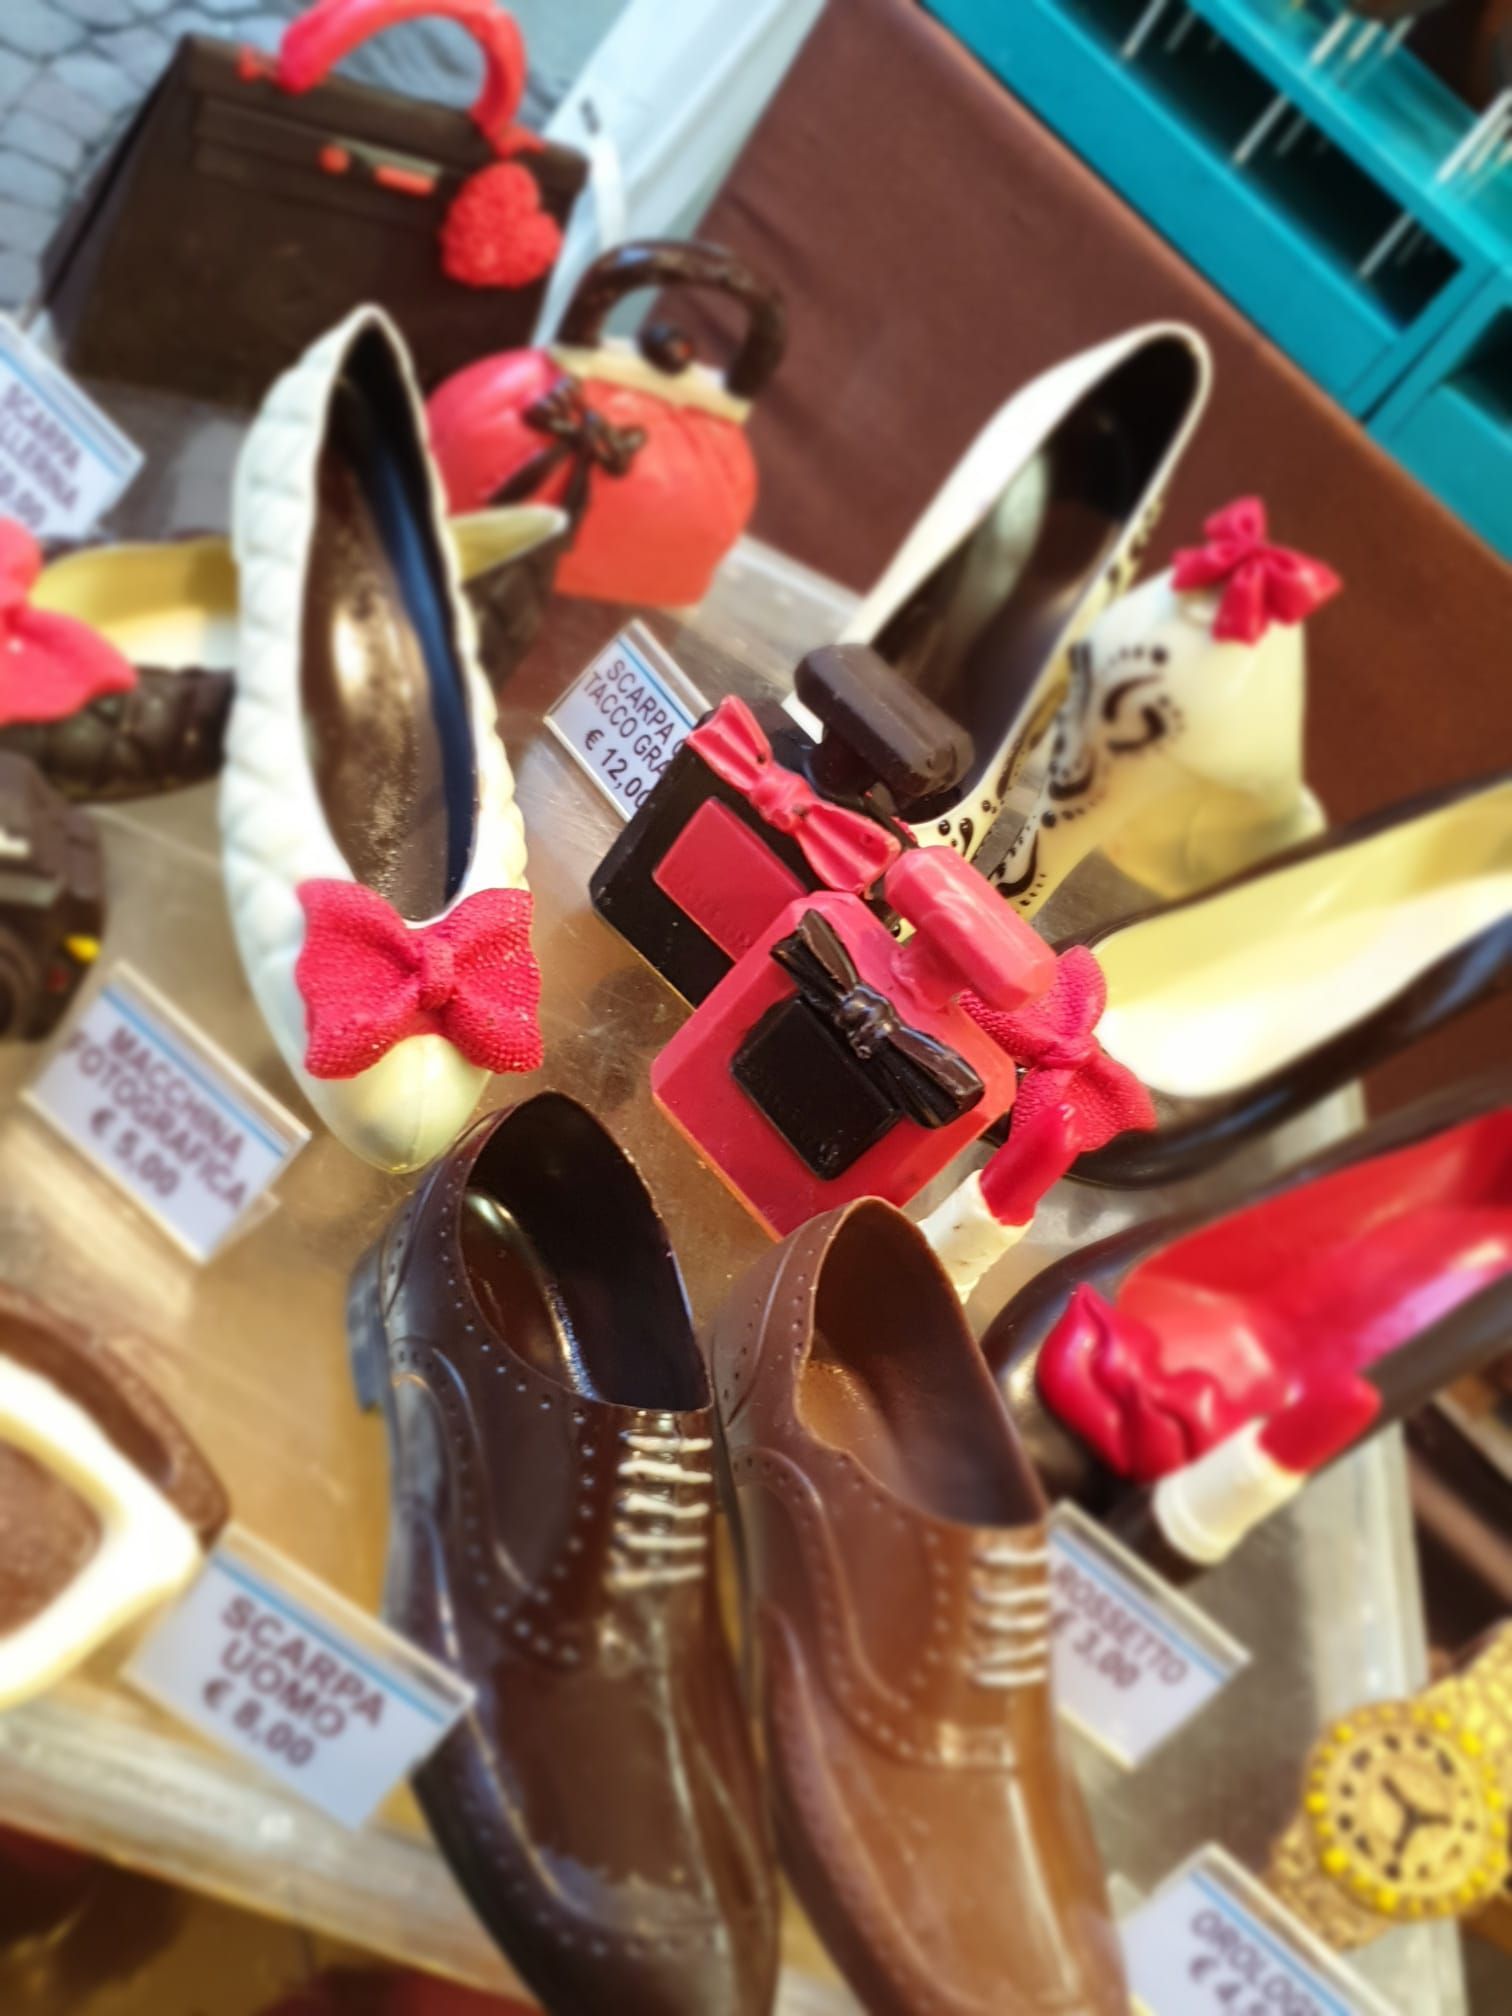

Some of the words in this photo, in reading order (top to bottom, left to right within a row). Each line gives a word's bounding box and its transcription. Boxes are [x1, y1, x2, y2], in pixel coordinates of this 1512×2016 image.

[3, 381, 80, 471] SCARPA
[584, 671, 638, 739] TACCO
[584, 729, 604, 751] €
[606, 660, 675, 744] SCARPA
[67, 1030, 247, 1209] FOTOGRAFICA
[90, 1107, 116, 1137] €
[109, 1026, 244, 1159] MACCHINA
[220, 1595, 387, 1728] SCARPA
[1054, 1562, 1189, 1686] ROSSETTO
[203, 1677, 232, 1710] €
[220, 1638, 348, 1739] UOMO
[1189, 1908, 1321, 2016] OROLOG
